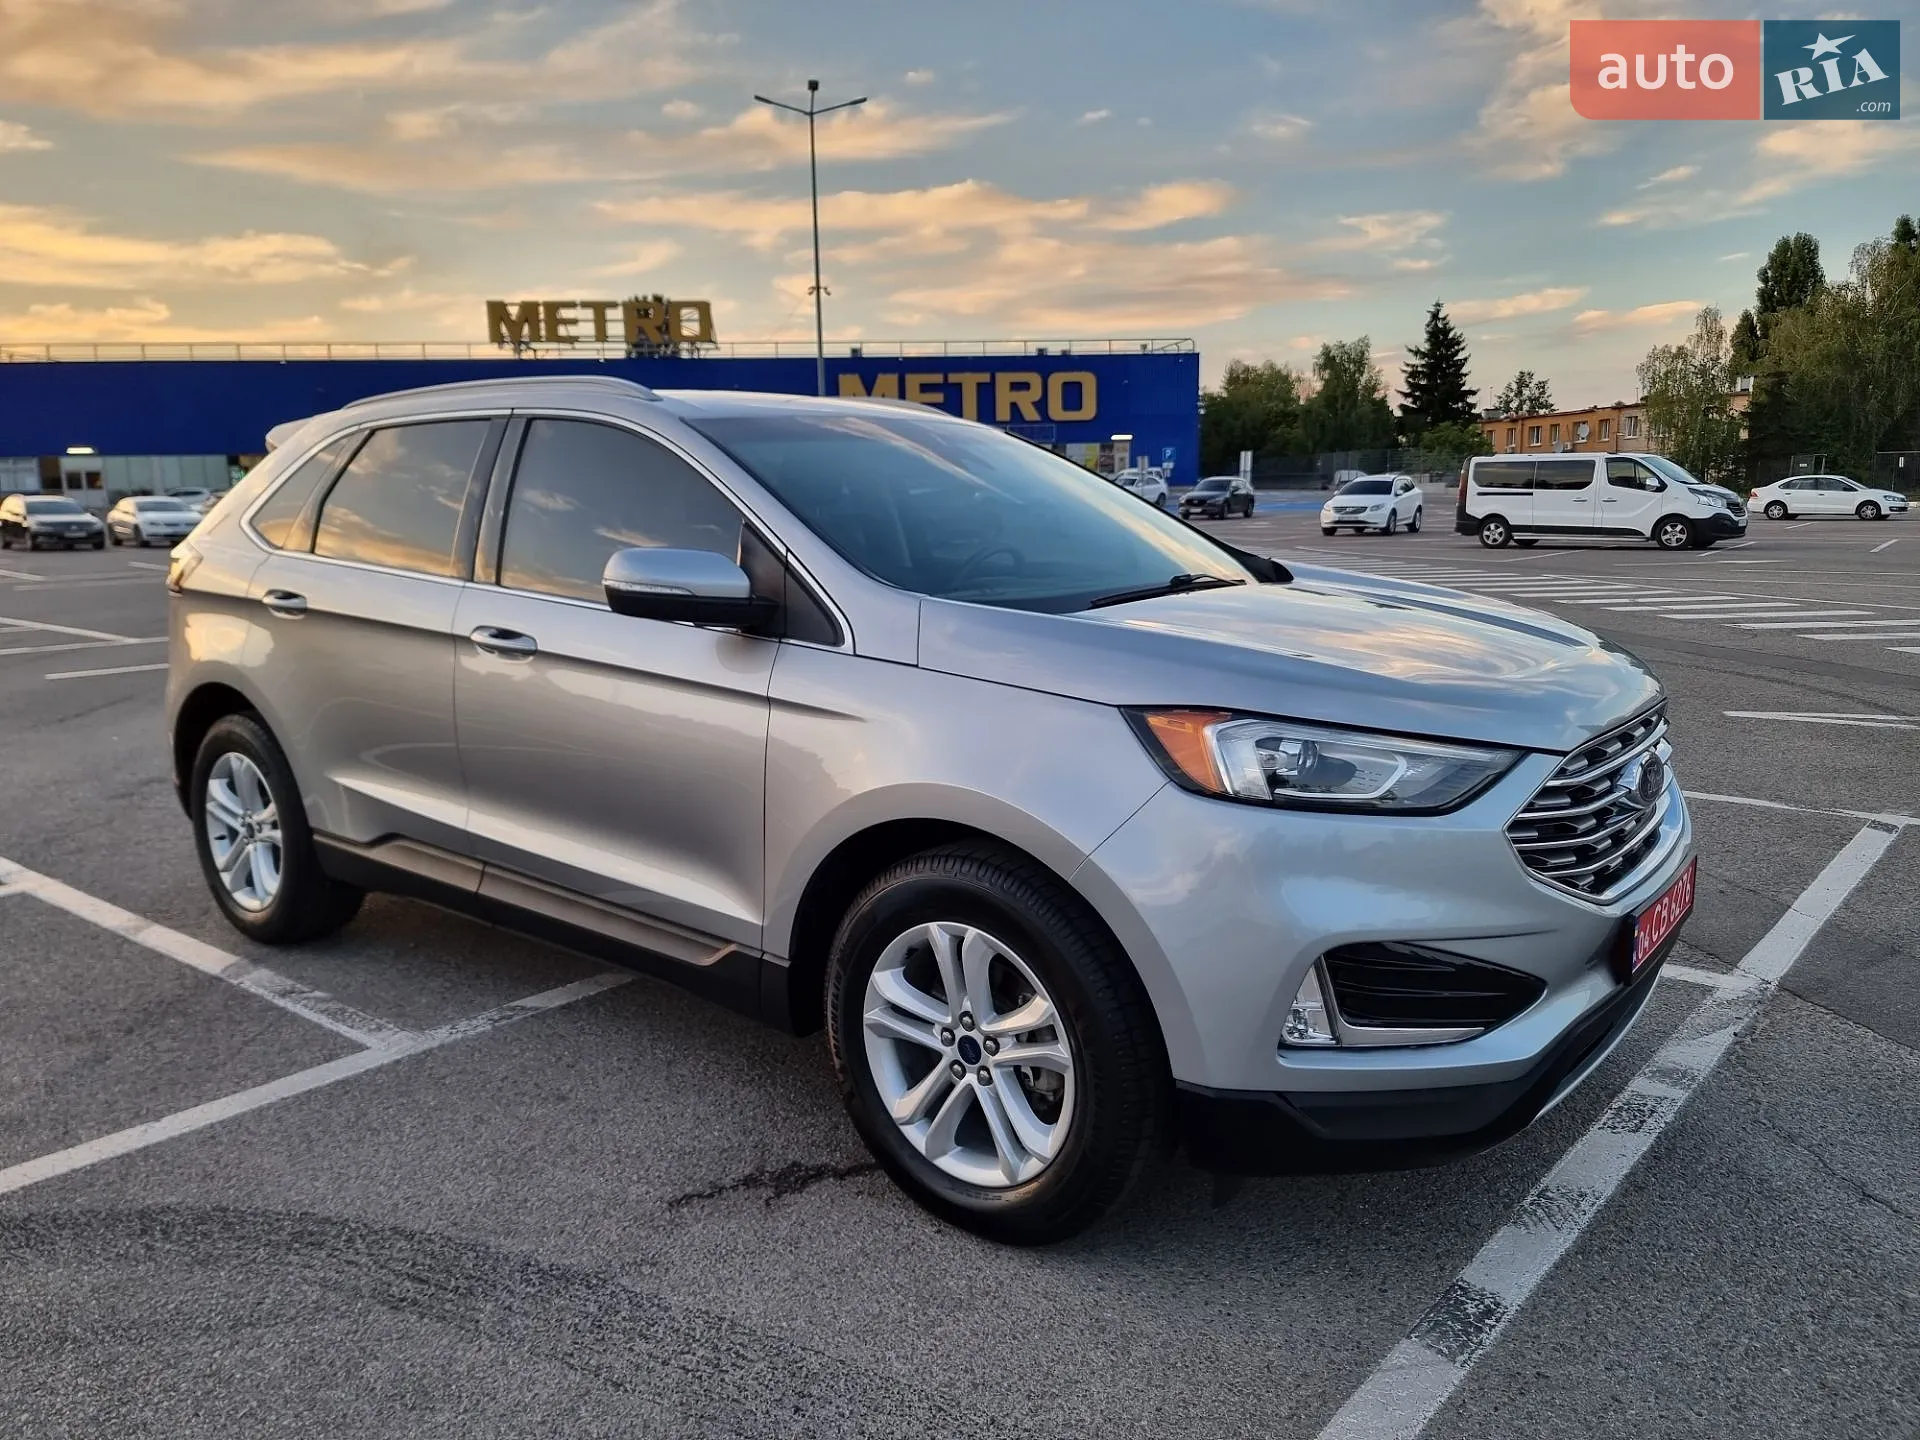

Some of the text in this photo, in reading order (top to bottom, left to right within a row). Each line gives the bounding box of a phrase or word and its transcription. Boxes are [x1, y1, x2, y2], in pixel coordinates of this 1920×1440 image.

[486, 299, 713, 344] METRO
[838, 371, 1098, 422] METRO
[1652, 896, 1669, 942] CB
[1670, 866, 1692, 922] 6276
